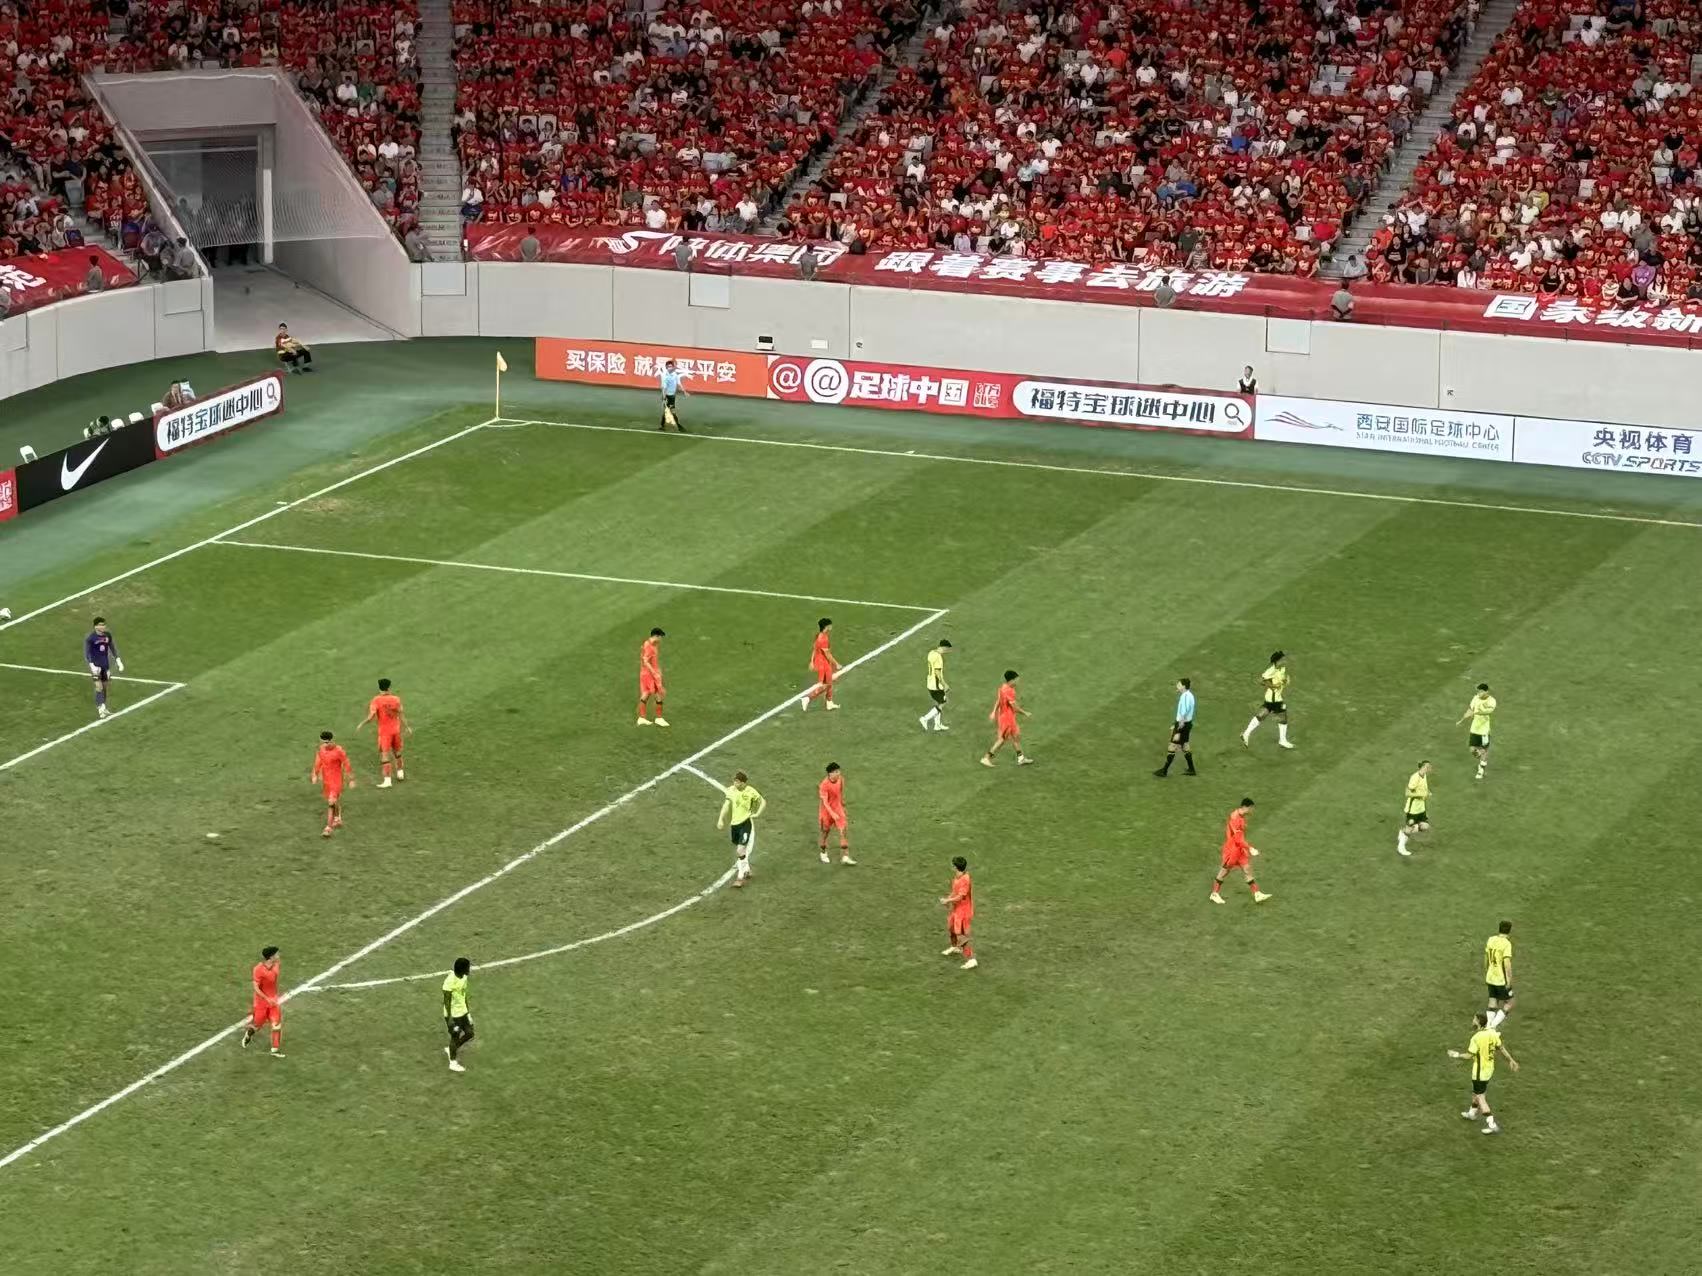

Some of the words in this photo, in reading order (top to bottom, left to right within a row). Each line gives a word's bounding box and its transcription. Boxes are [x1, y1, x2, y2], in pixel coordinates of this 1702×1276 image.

[874, 251, 1250, 298] 跟着赛事去旅游
[566, 350, 626, 376] 买保险
[166, 387, 263, 445] 福特宝球迷中心
[1031, 387, 1216, 424] 福特宝球迷中心
[1356, 413, 1500, 441] 西安国际足球中心
[1593, 427, 1694, 455] 央视体育
[1582, 451, 1622, 467] CCTV
[1622, 455, 1702, 473] SPORTS
